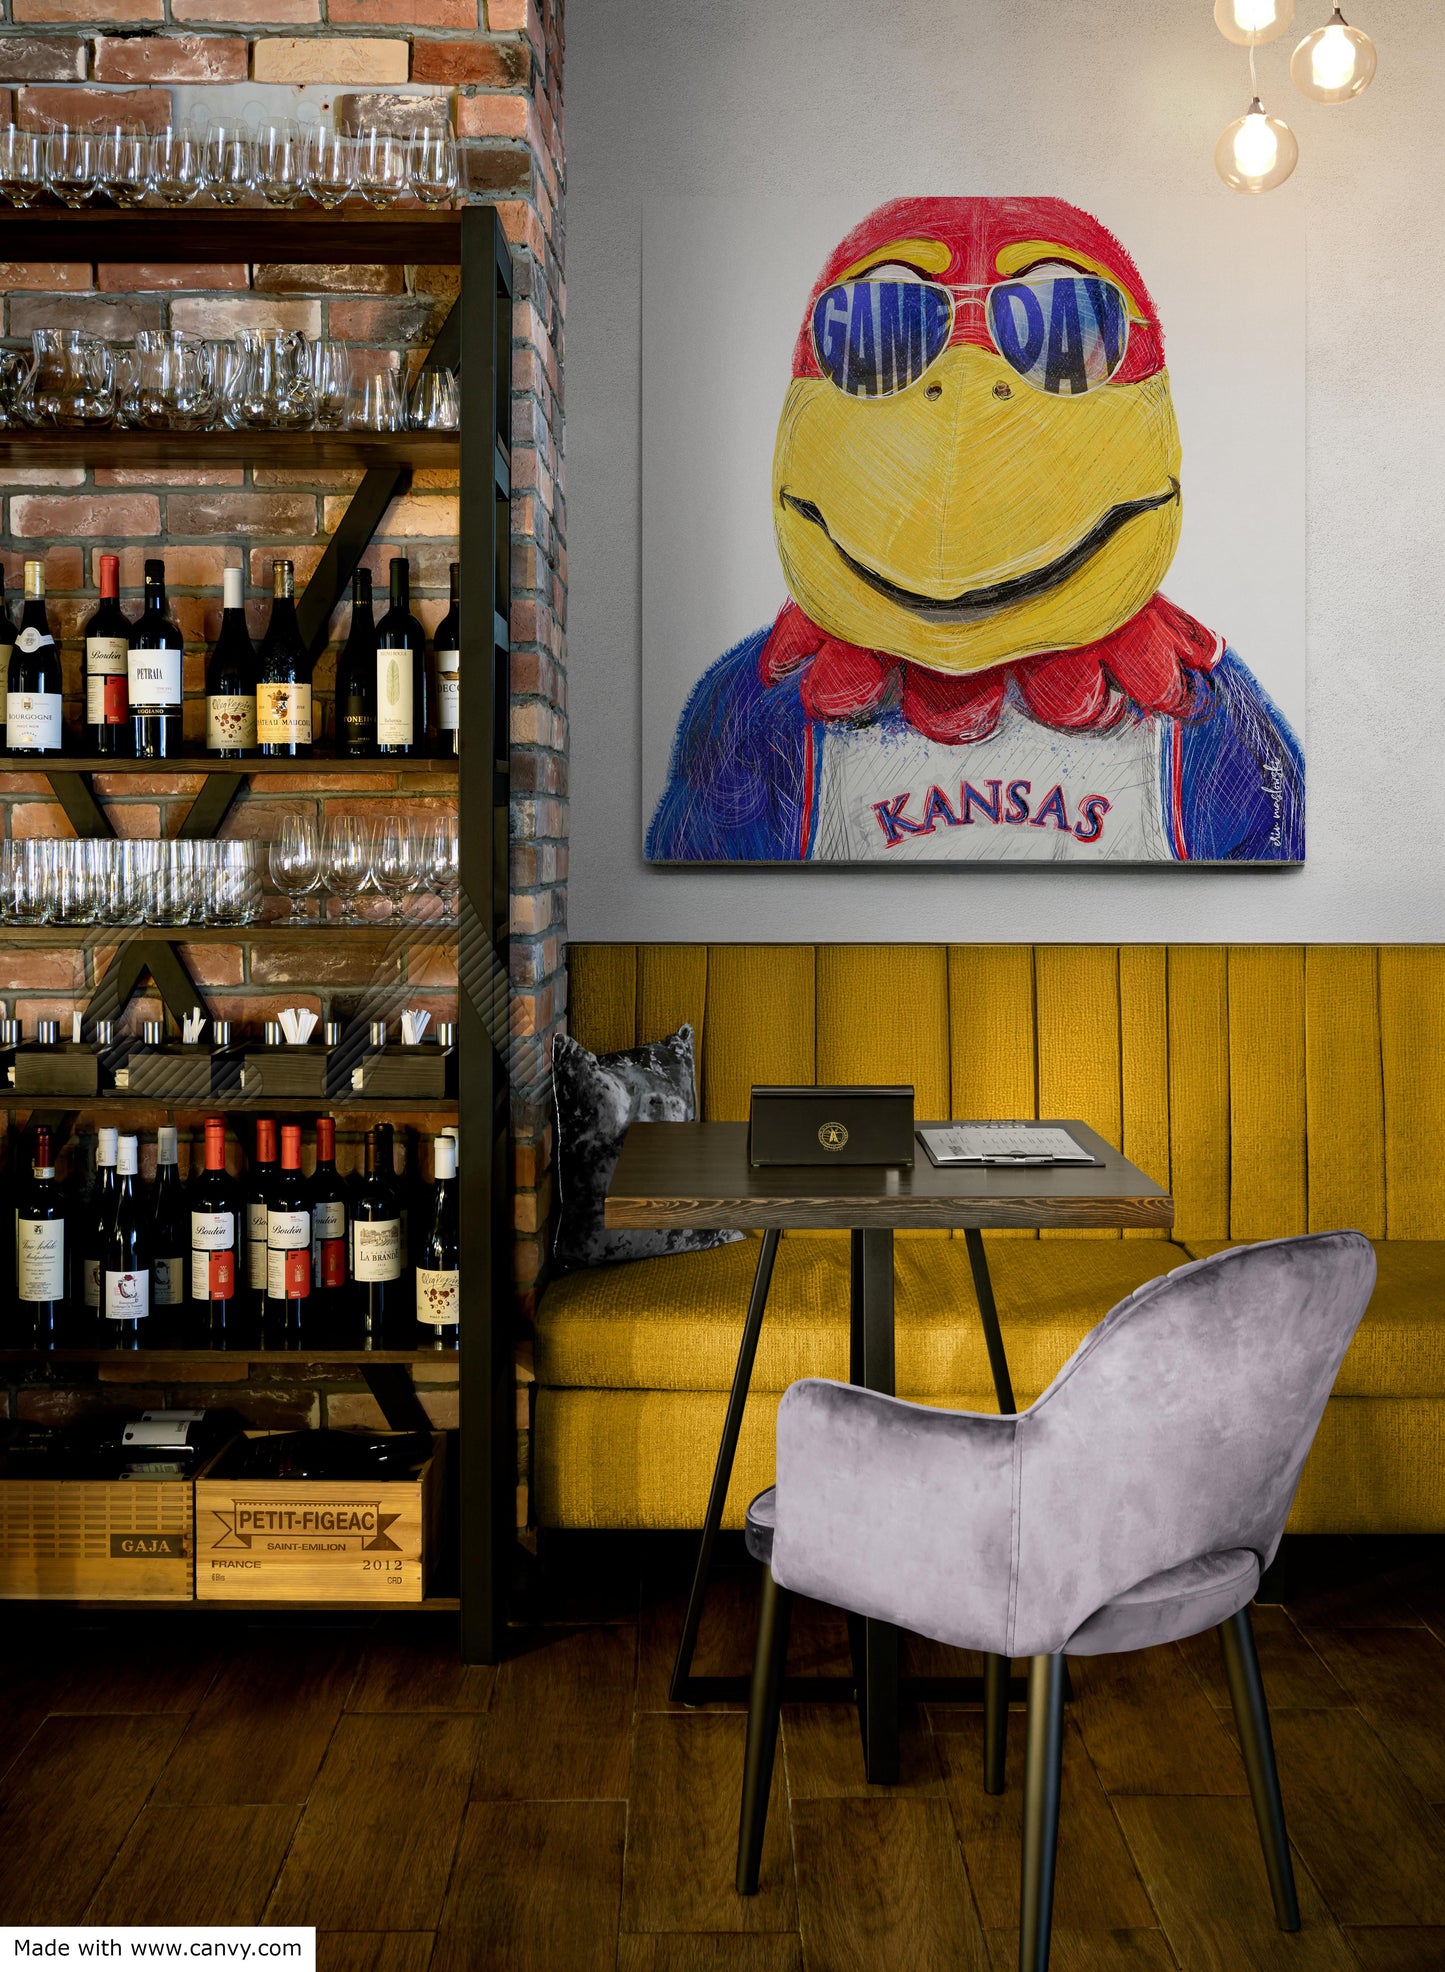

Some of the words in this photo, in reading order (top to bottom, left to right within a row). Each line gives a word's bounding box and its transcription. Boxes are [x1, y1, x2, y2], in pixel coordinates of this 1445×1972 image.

[136, 668, 163, 680] PETRAIA
[871, 779, 1113, 849] KANSAS
[239, 1510, 375, 1531] PETIT-FIGEAC
[121, 1540, 172, 1553] GAJA
[267, 1542, 346, 1551] SAINT-EMILION
[211, 1559, 262, 1569] FRANCE
[362, 1559, 403, 1571] 2012
